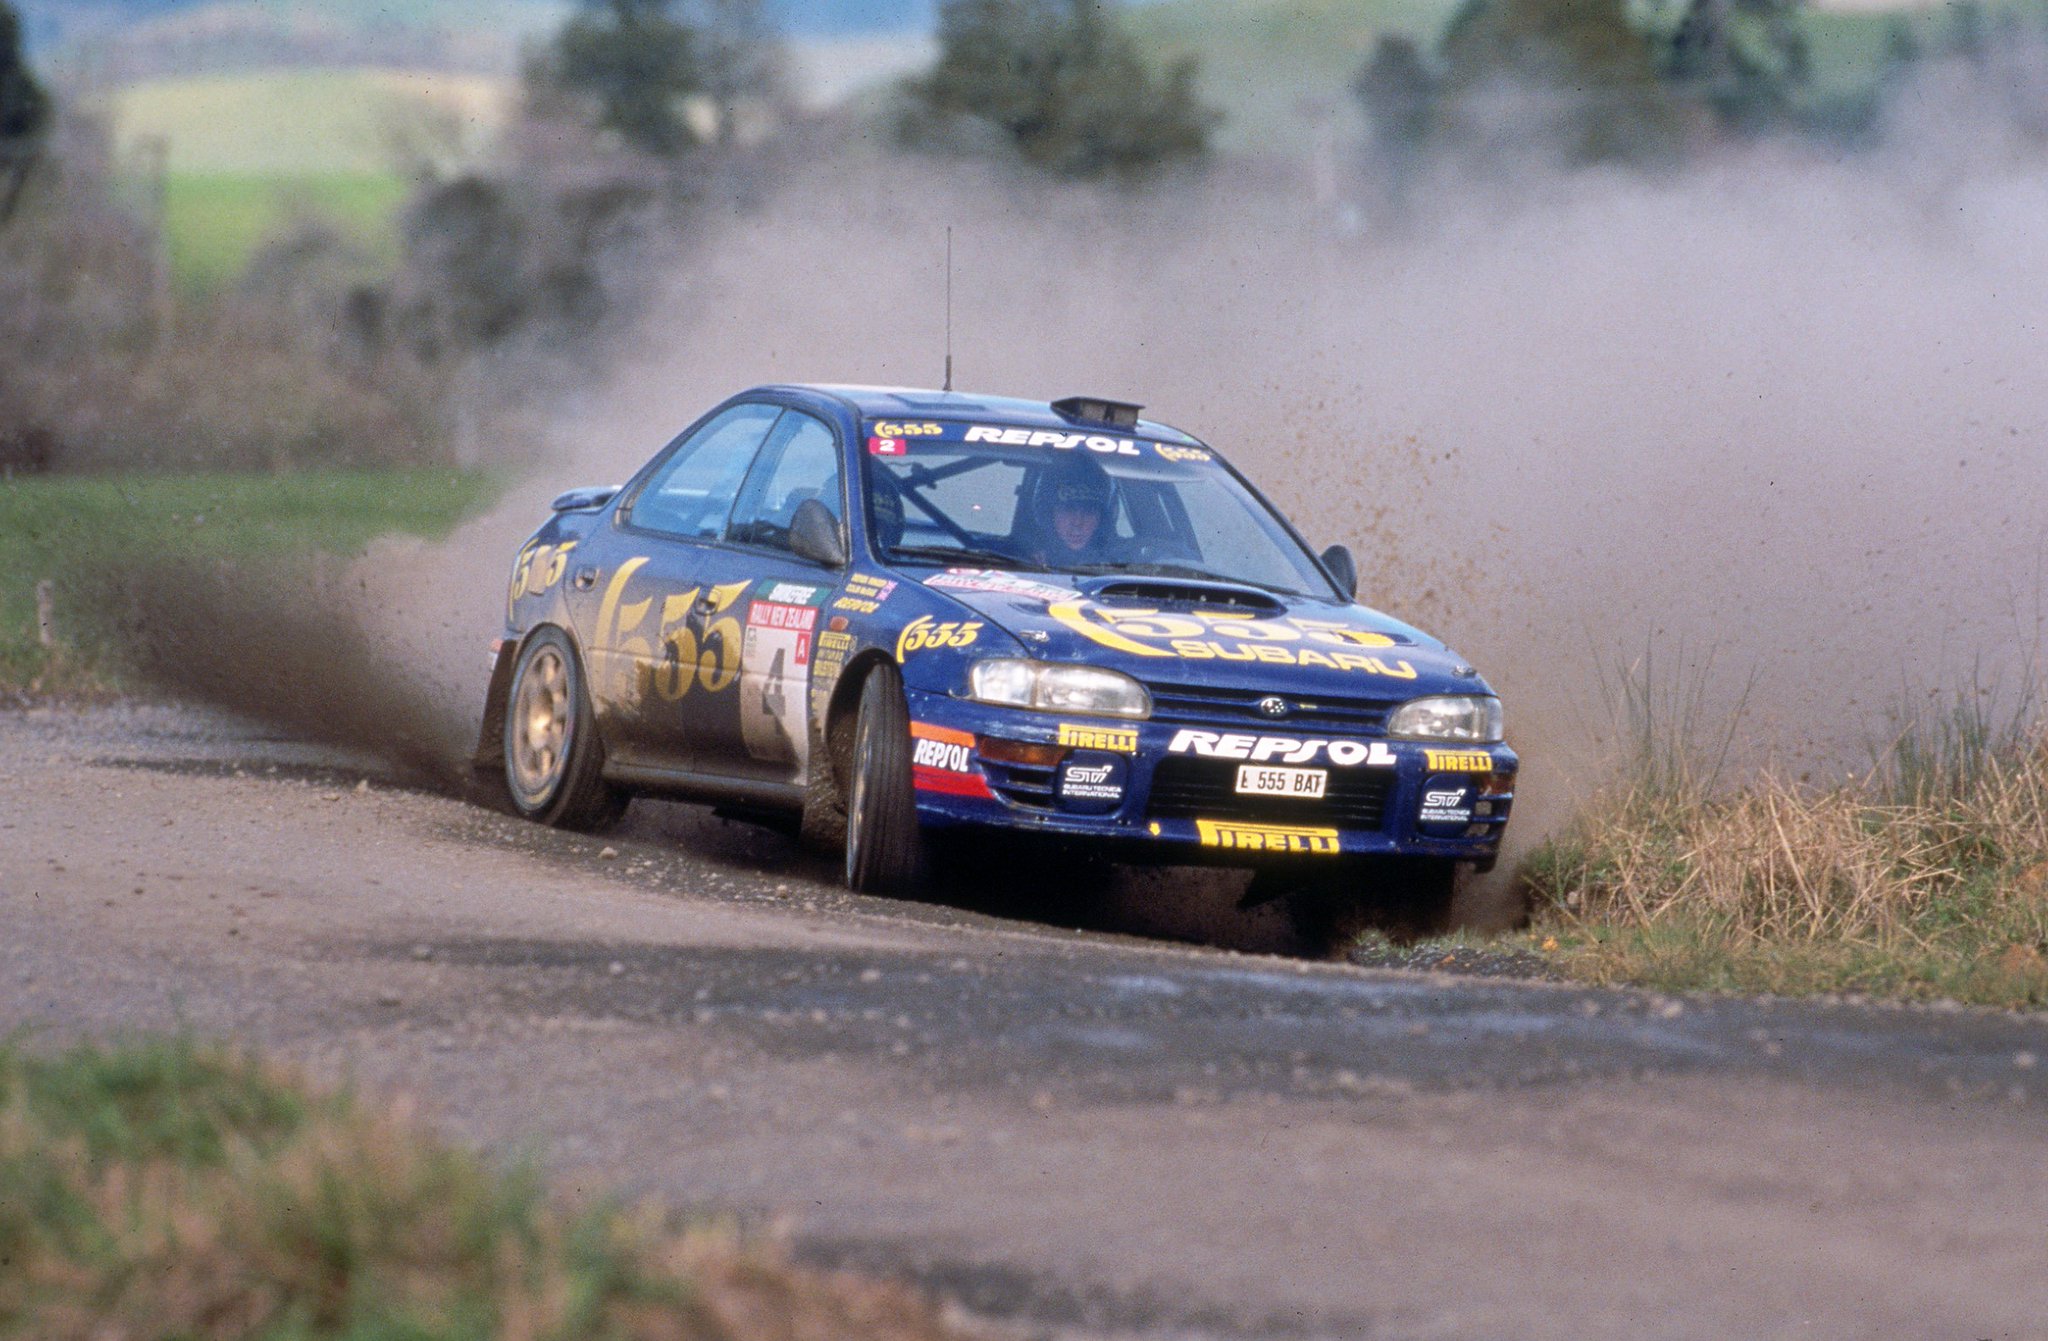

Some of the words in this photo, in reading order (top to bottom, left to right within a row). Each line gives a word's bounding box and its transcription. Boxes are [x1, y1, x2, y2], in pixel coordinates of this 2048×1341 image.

[879, 422, 943, 437] 555
[964, 426, 1140, 456] REPSOL
[879, 439, 896, 453] 2
[750, 603, 773, 625] RALLY
[1080, 605, 1412, 651] 555
[600, 562, 753, 701] 555
[900, 618, 984, 655] 555
[797, 638, 806, 659] A
[1170, 639, 1418, 680] SUBARU
[762, 648, 786, 735] 4
[1058, 723, 1138, 752] PIRELLI
[1168, 729, 1397, 766] REPSOL
[913, 739, 969, 773] REPSOL
[1424, 749, 1493, 771] PIRELLI
[1062, 789, 1120, 799] INTERNATIONAL
[1063, 783, 1092, 791] SUBARU
[1256, 771, 1285, 791] 555
[1293, 774, 1323, 794] BAT
[1196, 819, 1341, 855] PIRELLI
